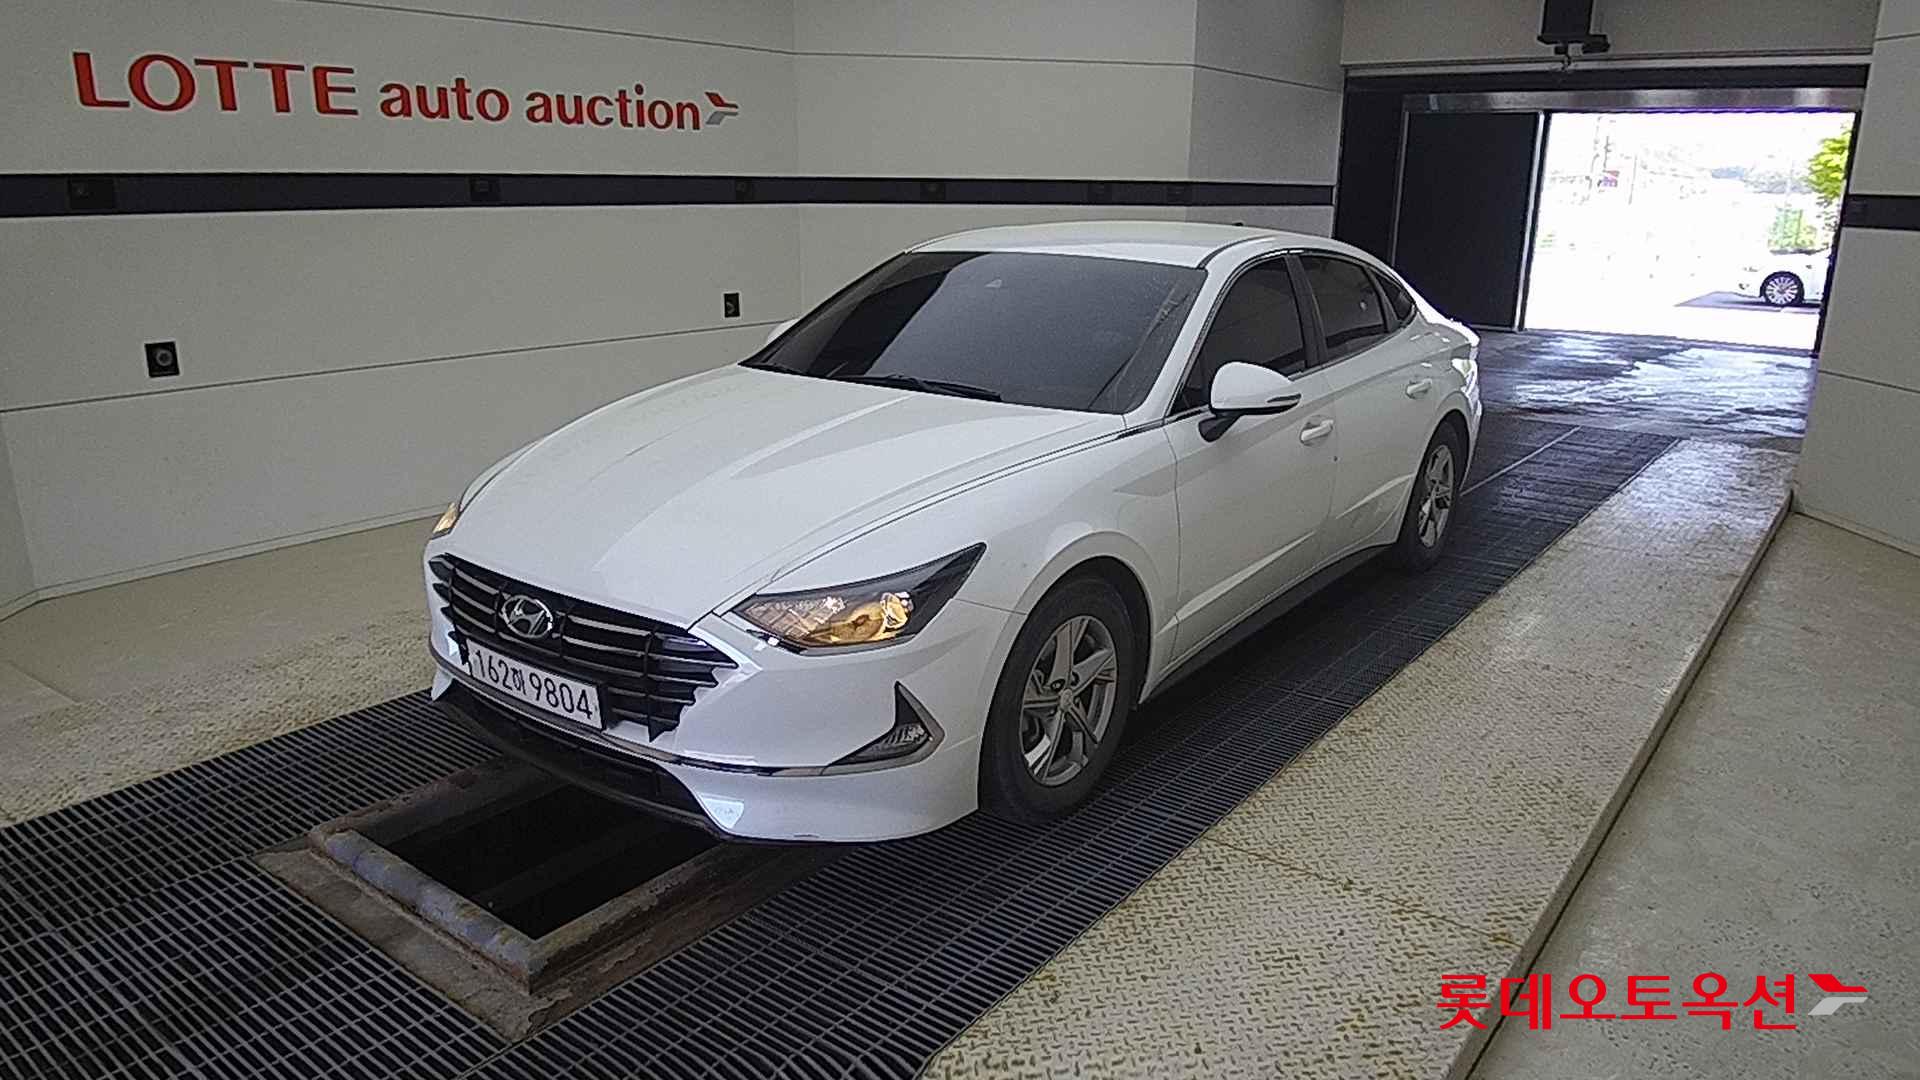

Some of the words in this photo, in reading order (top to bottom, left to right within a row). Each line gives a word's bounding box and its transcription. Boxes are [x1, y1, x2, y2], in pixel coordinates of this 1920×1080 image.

[72, 51, 358, 116] LOTTE
[379, 77, 510, 122] auto
[525, 84, 702, 131] auction
